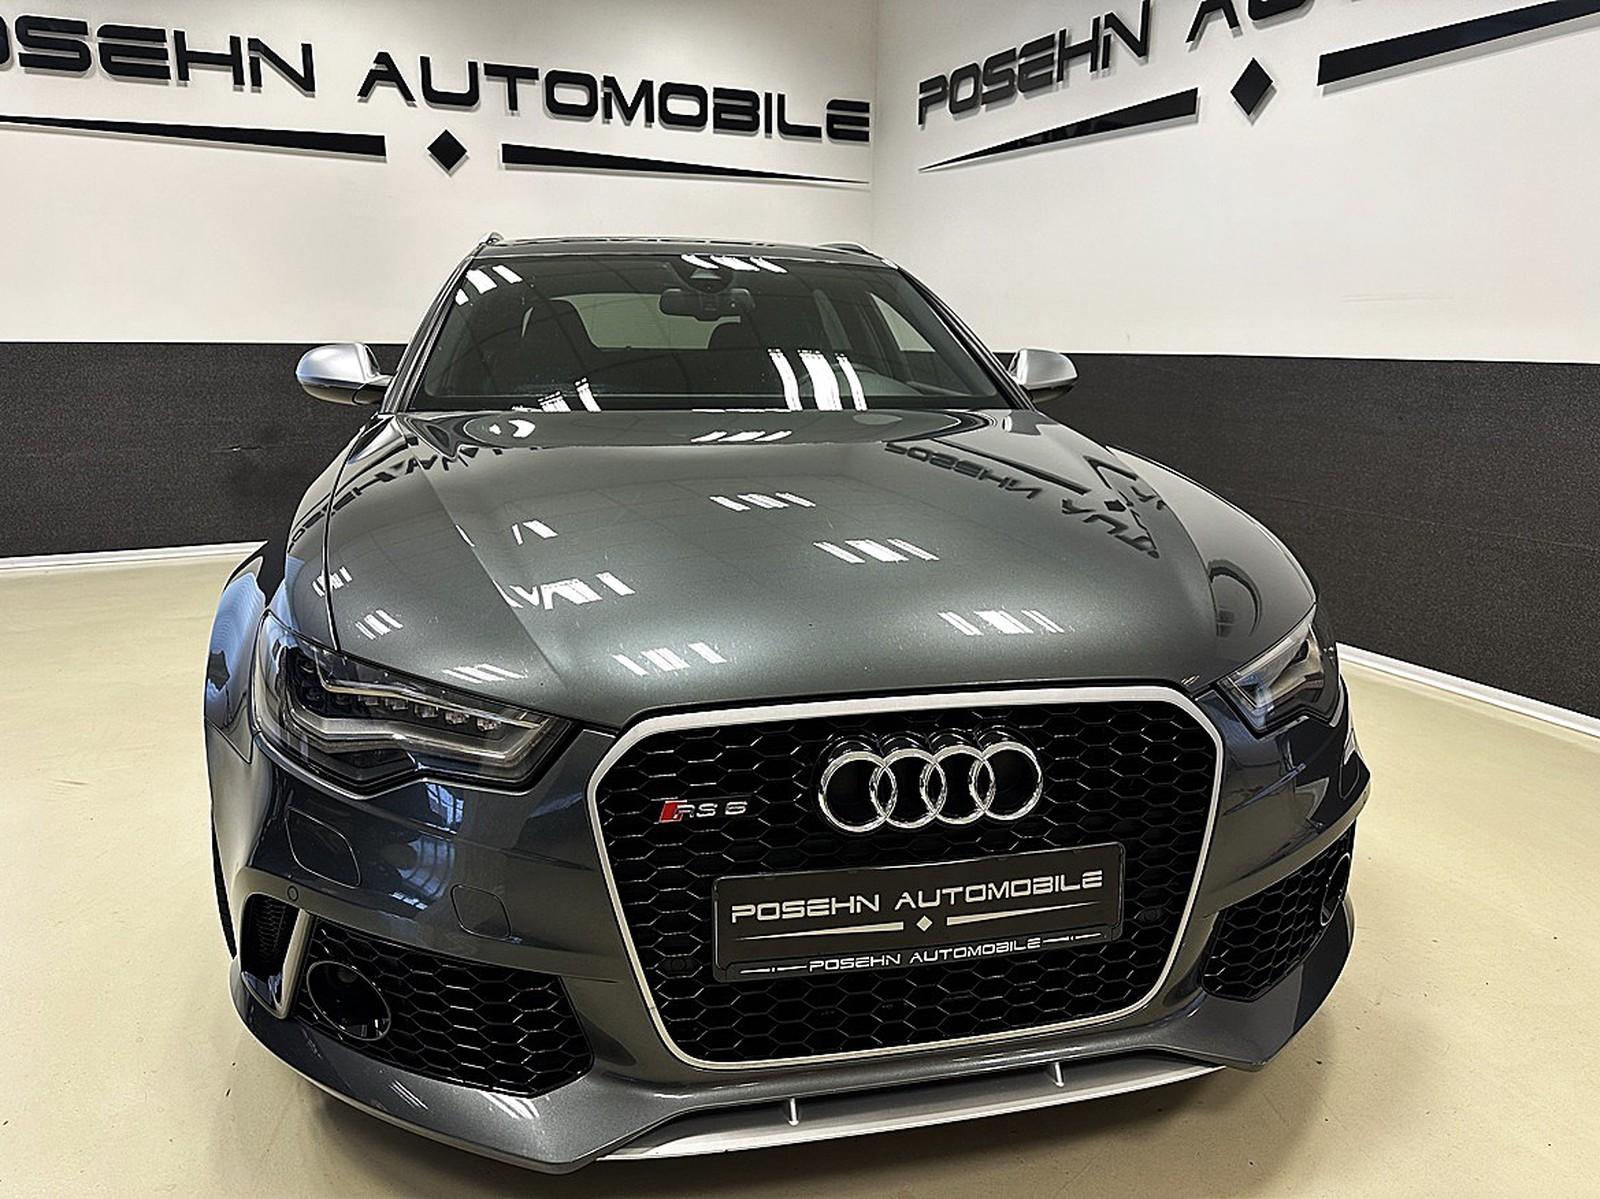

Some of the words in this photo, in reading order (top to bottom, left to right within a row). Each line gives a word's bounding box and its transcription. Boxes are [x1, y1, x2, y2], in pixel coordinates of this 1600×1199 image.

[0, 14, 316, 94] SEHN
[356, 51, 870, 142] AUTOMOBILE
[917, 0, 1150, 126] POSEHN
[731, 894, 880, 924] POSEHN
[894, 869, 1103, 911] AUTOMOBILE
[809, 953, 901, 973] POSEHN
[908, 937, 1041, 964] AUTOMOBILE
